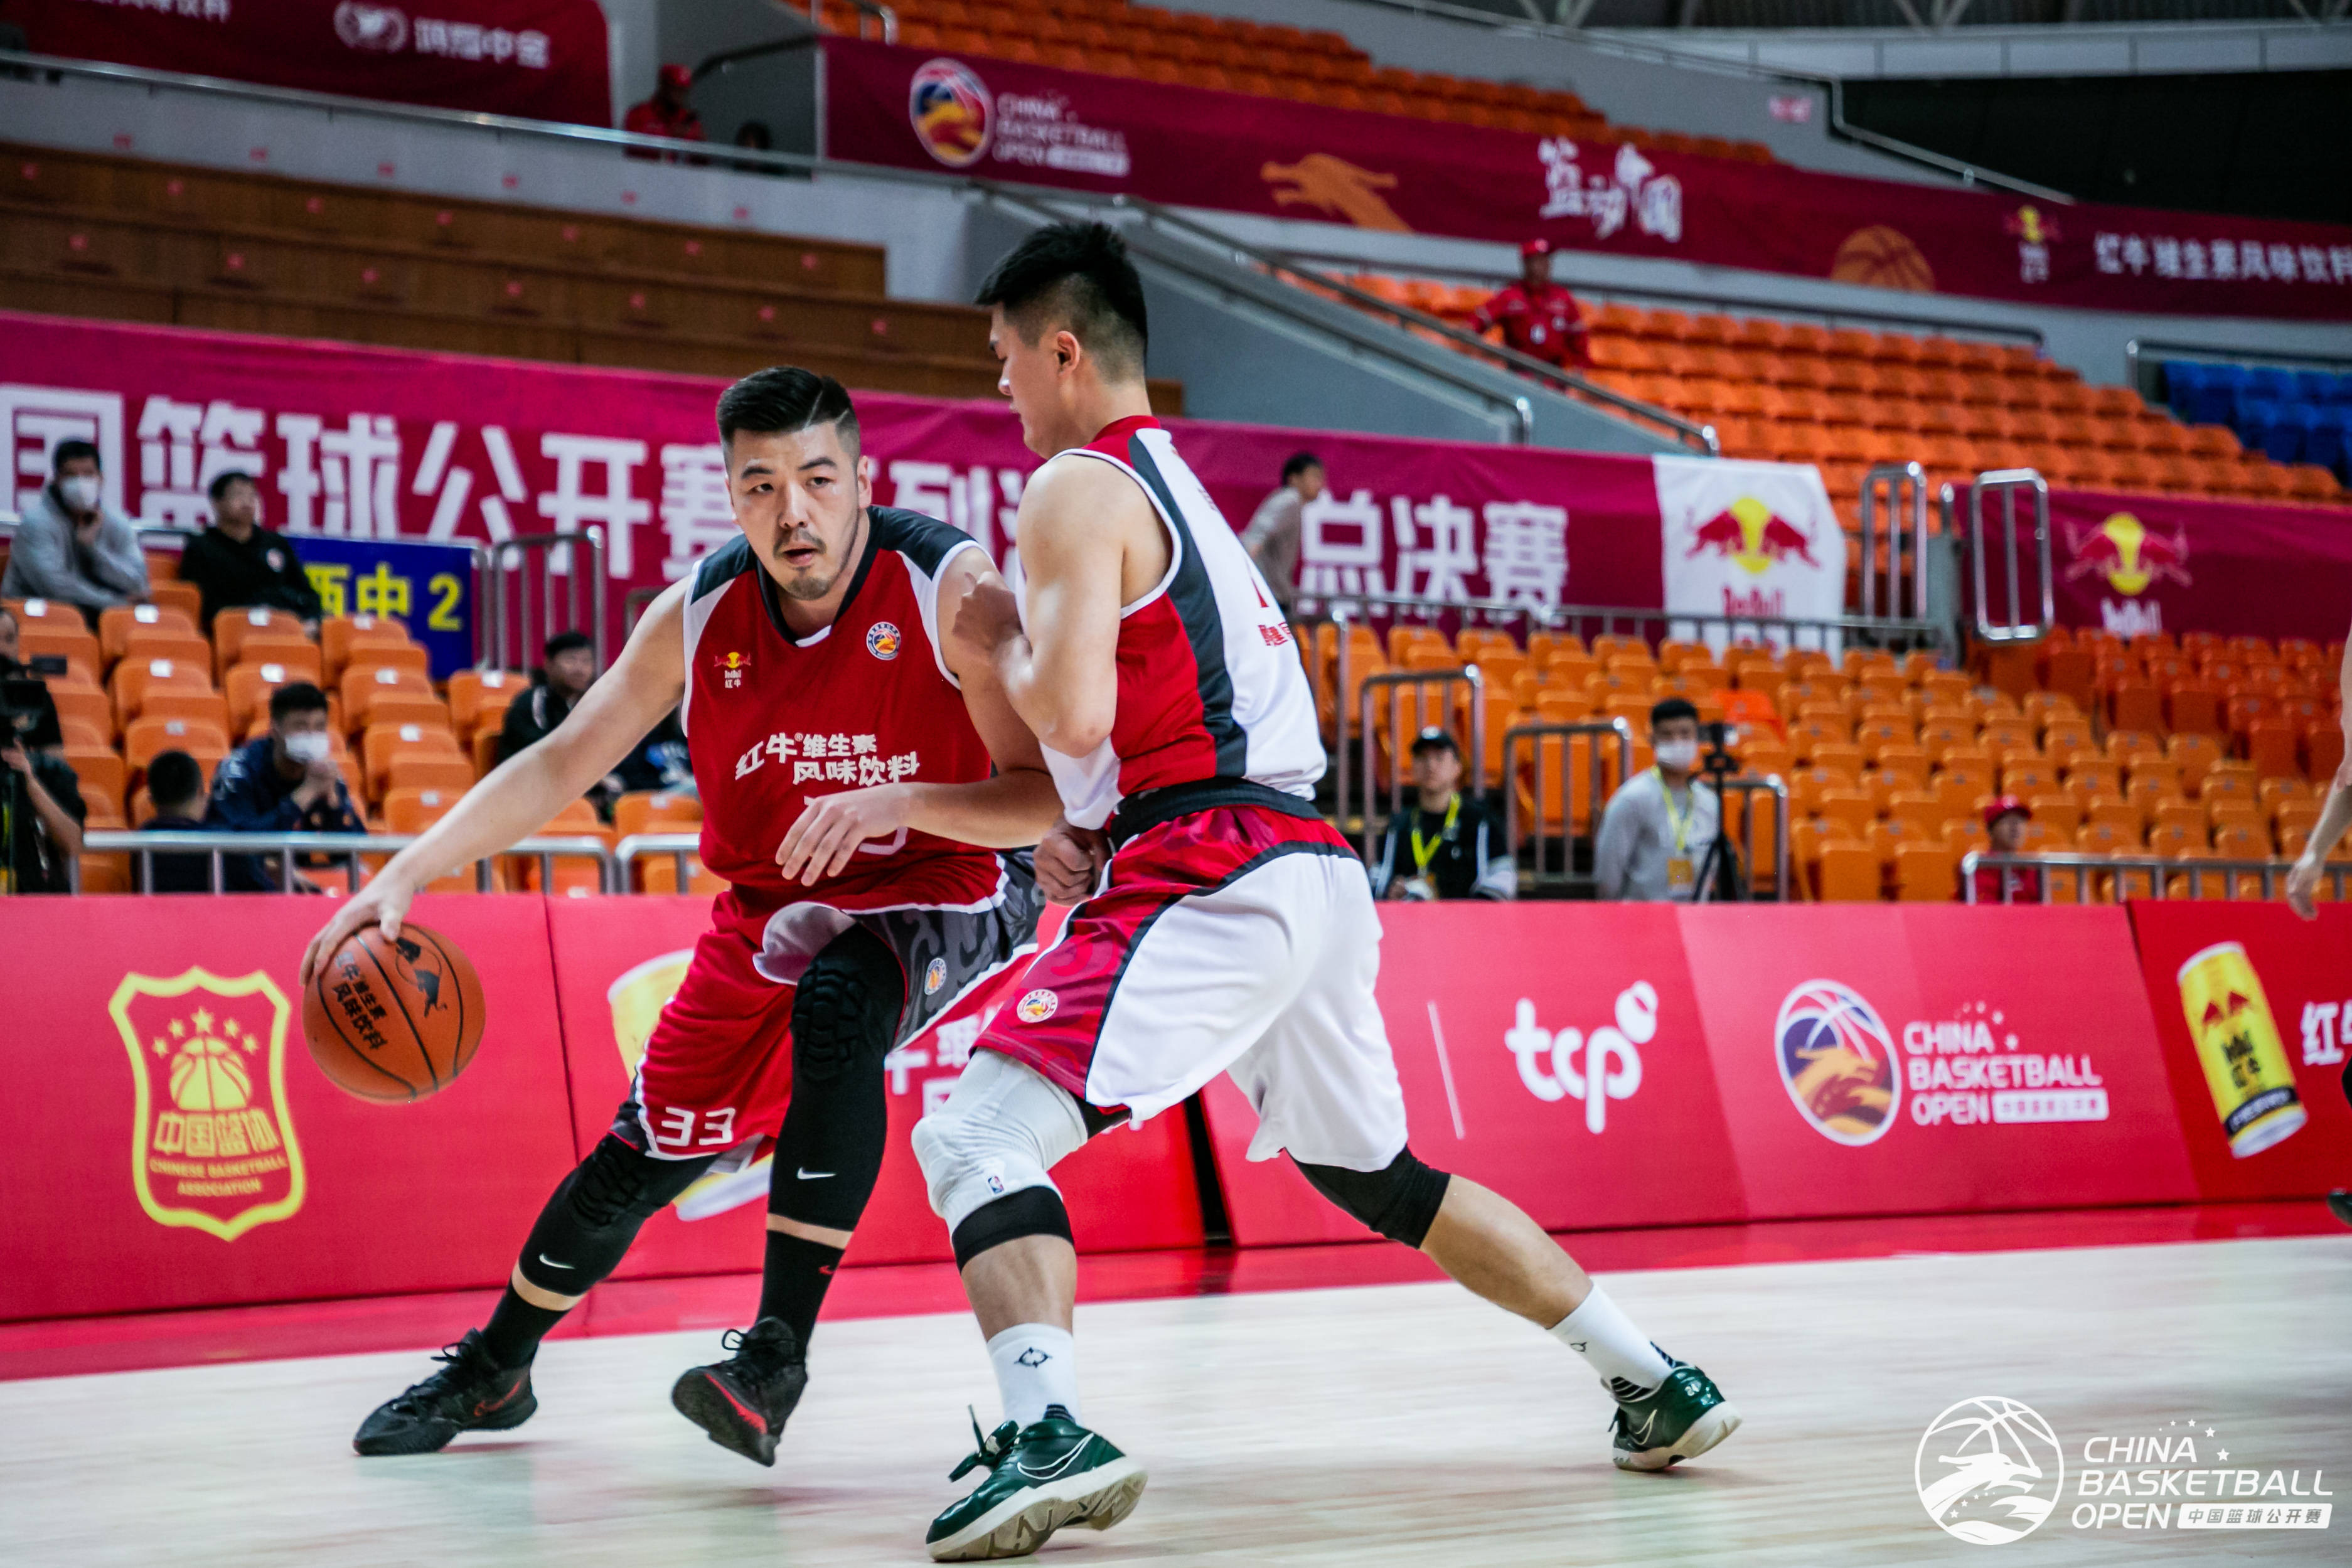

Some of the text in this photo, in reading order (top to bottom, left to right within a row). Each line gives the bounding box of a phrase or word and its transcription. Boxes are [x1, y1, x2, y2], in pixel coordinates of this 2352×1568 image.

[1297, 488, 1568, 626] 总决赛
[429, 572, 462, 631] 2
[793, 751, 920, 786] 风味饮料
[1903, 1020, 1996, 1055] CHINA
[1504, 990, 1650, 1134] tcp
[1908, 1053, 2103, 1091] BASKETBALL
[656, 1106, 736, 1147] 33
[1911, 1092, 1991, 1126] OPEN
[149, 1155, 288, 1178] CHINESE BASKETBALL
[177, 1178, 262, 1197] ASSOCIATION
